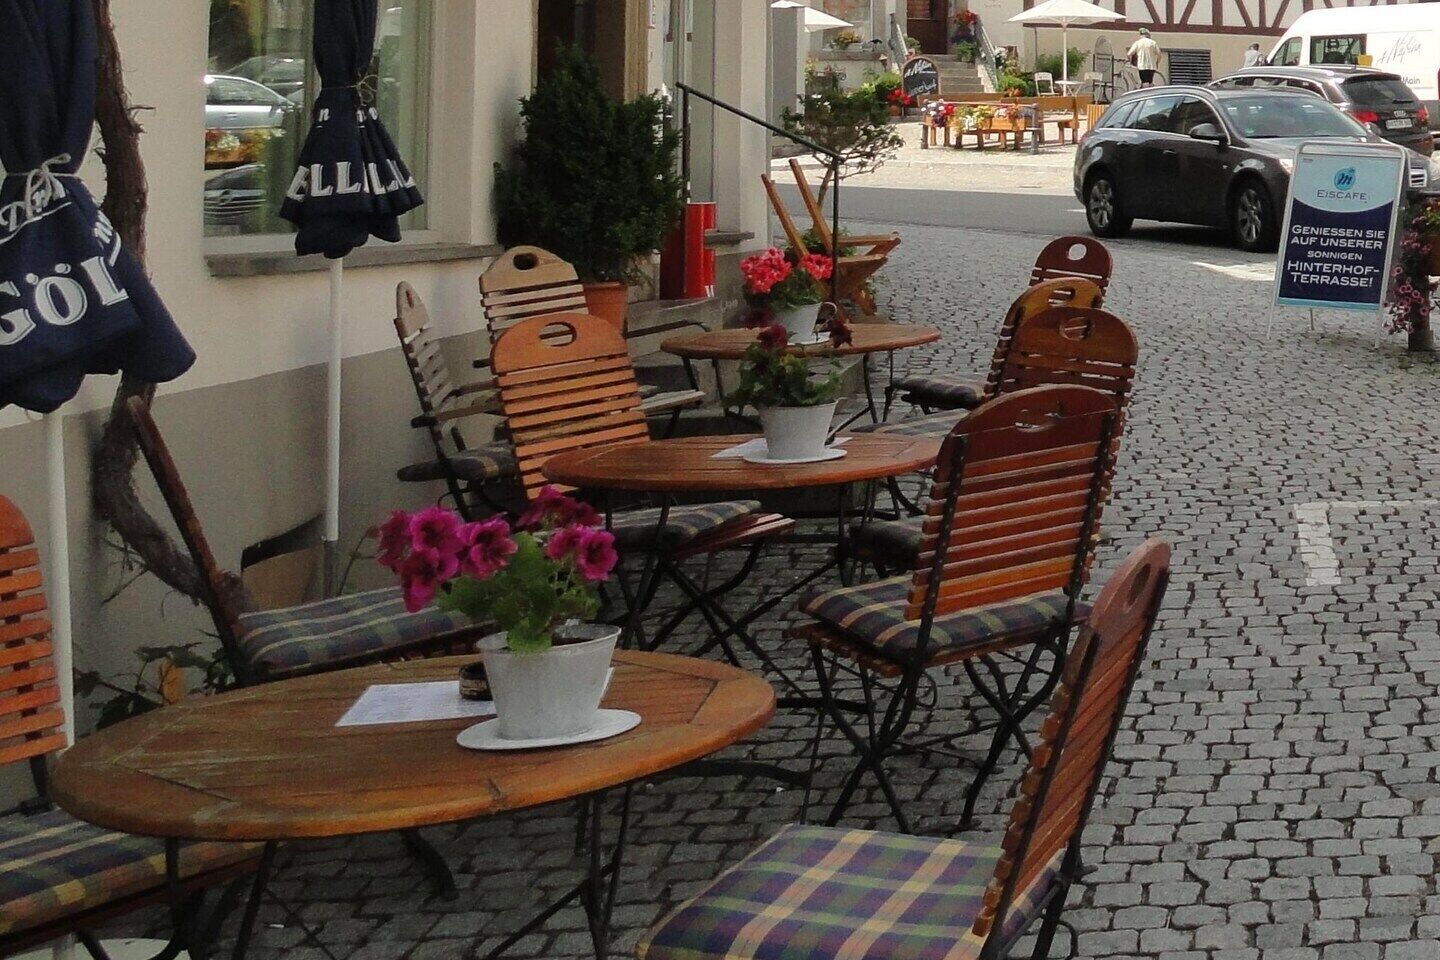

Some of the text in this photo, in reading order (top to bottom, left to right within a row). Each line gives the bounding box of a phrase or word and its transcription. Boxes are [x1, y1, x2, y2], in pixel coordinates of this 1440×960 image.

[1291, 224, 1386, 239] GENIESSEN SIE
[1290, 236, 1383, 250] AUF UNSERER
[1307, 250, 1363, 261] SONNIGEN
[1287, 260, 1380, 274] HINTERHOF-
[1290, 272, 1374, 288] TERRASSE!
